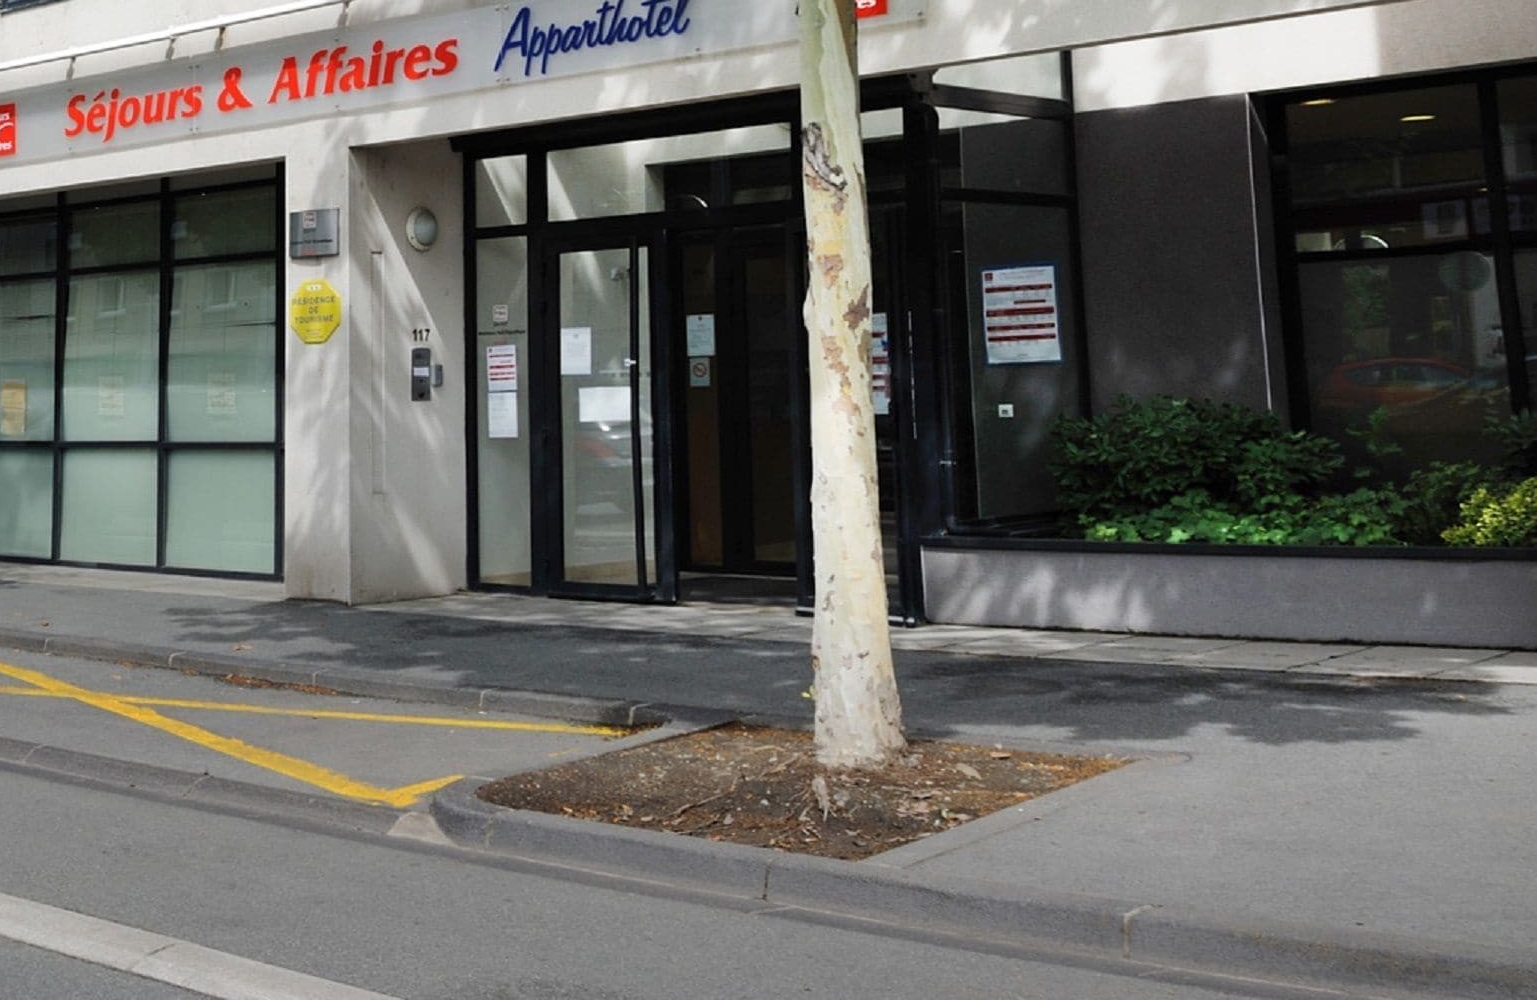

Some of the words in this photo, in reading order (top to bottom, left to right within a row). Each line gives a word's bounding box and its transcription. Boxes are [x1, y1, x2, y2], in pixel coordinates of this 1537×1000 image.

[64, 83, 203, 143] Séjours
[217, 66, 254, 113] &
[267, 38, 460, 105] Affaires
[411, 328, 431, 342] 117
